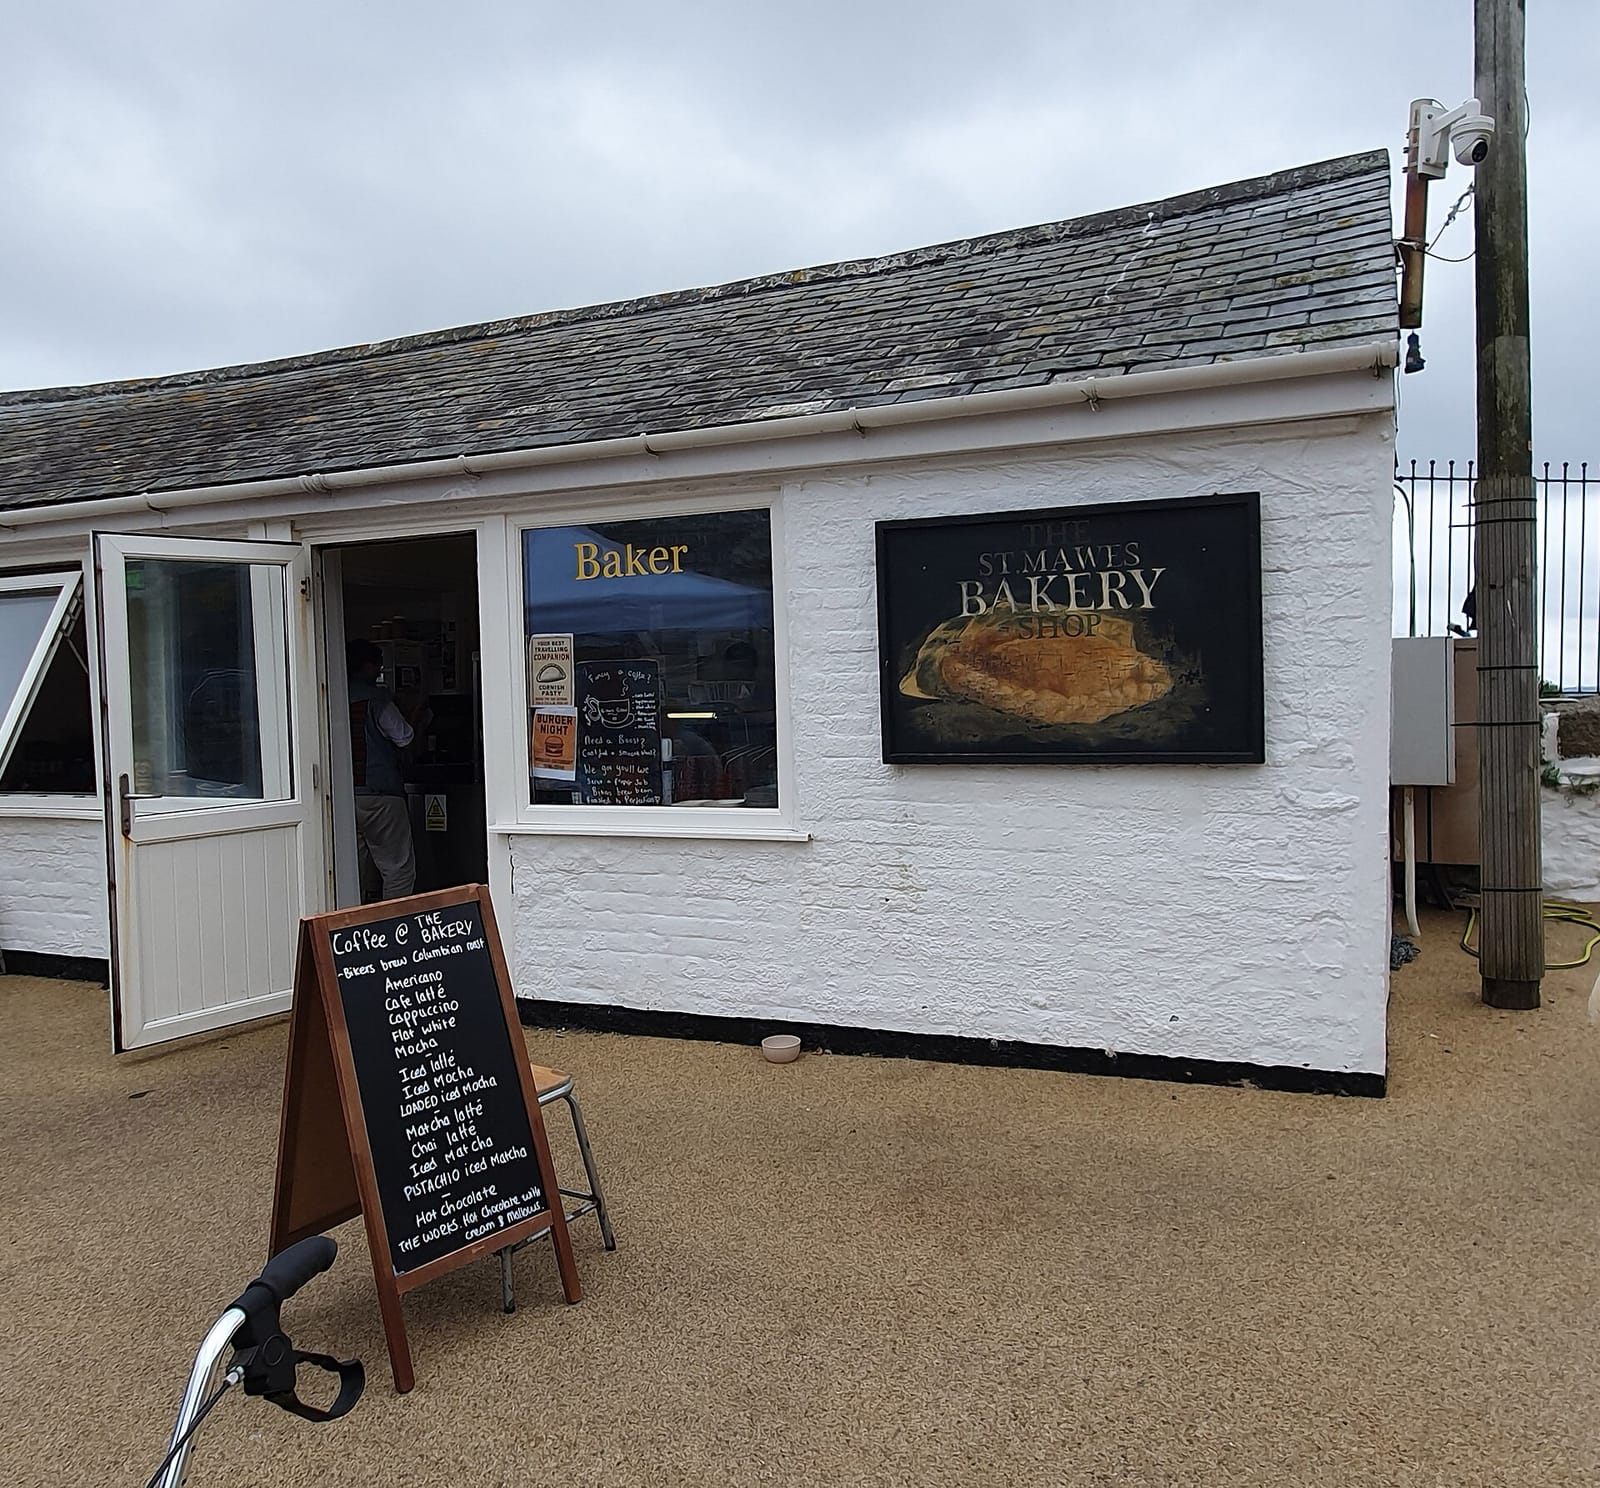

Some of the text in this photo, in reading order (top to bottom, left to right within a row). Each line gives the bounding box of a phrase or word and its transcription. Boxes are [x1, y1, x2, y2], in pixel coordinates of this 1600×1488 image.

[1023, 519, 1090, 545] THE
[574, 542, 688, 581] Baker
[956, 567, 1166, 618] BAKERY
[1017, 613, 1101, 640] SHOP
[533, 653, 570, 661] COMPANION
[536, 713, 573, 726] BURGER
[540, 724, 568, 736] NIGHT
[332, 929, 388, 955] Coffee
[414, 911, 443, 929] THE
[421, 919, 473, 944] BAKERY
[380, 955, 407, 972] brew
[412, 943, 463, 963] Columbian
[466, 938, 485, 951] roast
[385, 970, 443, 993] Americano
[389, 1000, 459, 1027] Cappuccino
[392, 1016, 456, 1043] Flat white
[394, 1037, 438, 1059] Mocha
[399, 1064, 427, 1083] Iced
[402, 1066, 474, 1100] Iced Mocha
[400, 1075, 497, 1117] LOADED iced Mocha
[405, 1115, 450, 1141] Matcha
[411, 1138, 437, 1158] Chai
[403, 1147, 527, 1201] PISTACHIO iced Matcha
[409, 1158, 438, 1178] Iced
[416, 1184, 498, 1228] Hot chocolate
[398, 1235, 420, 1253] THE
[463, 1212, 479, 1227] Hot
[522, 1186, 541, 1202] with
[465, 1222, 495, 1240] cream
